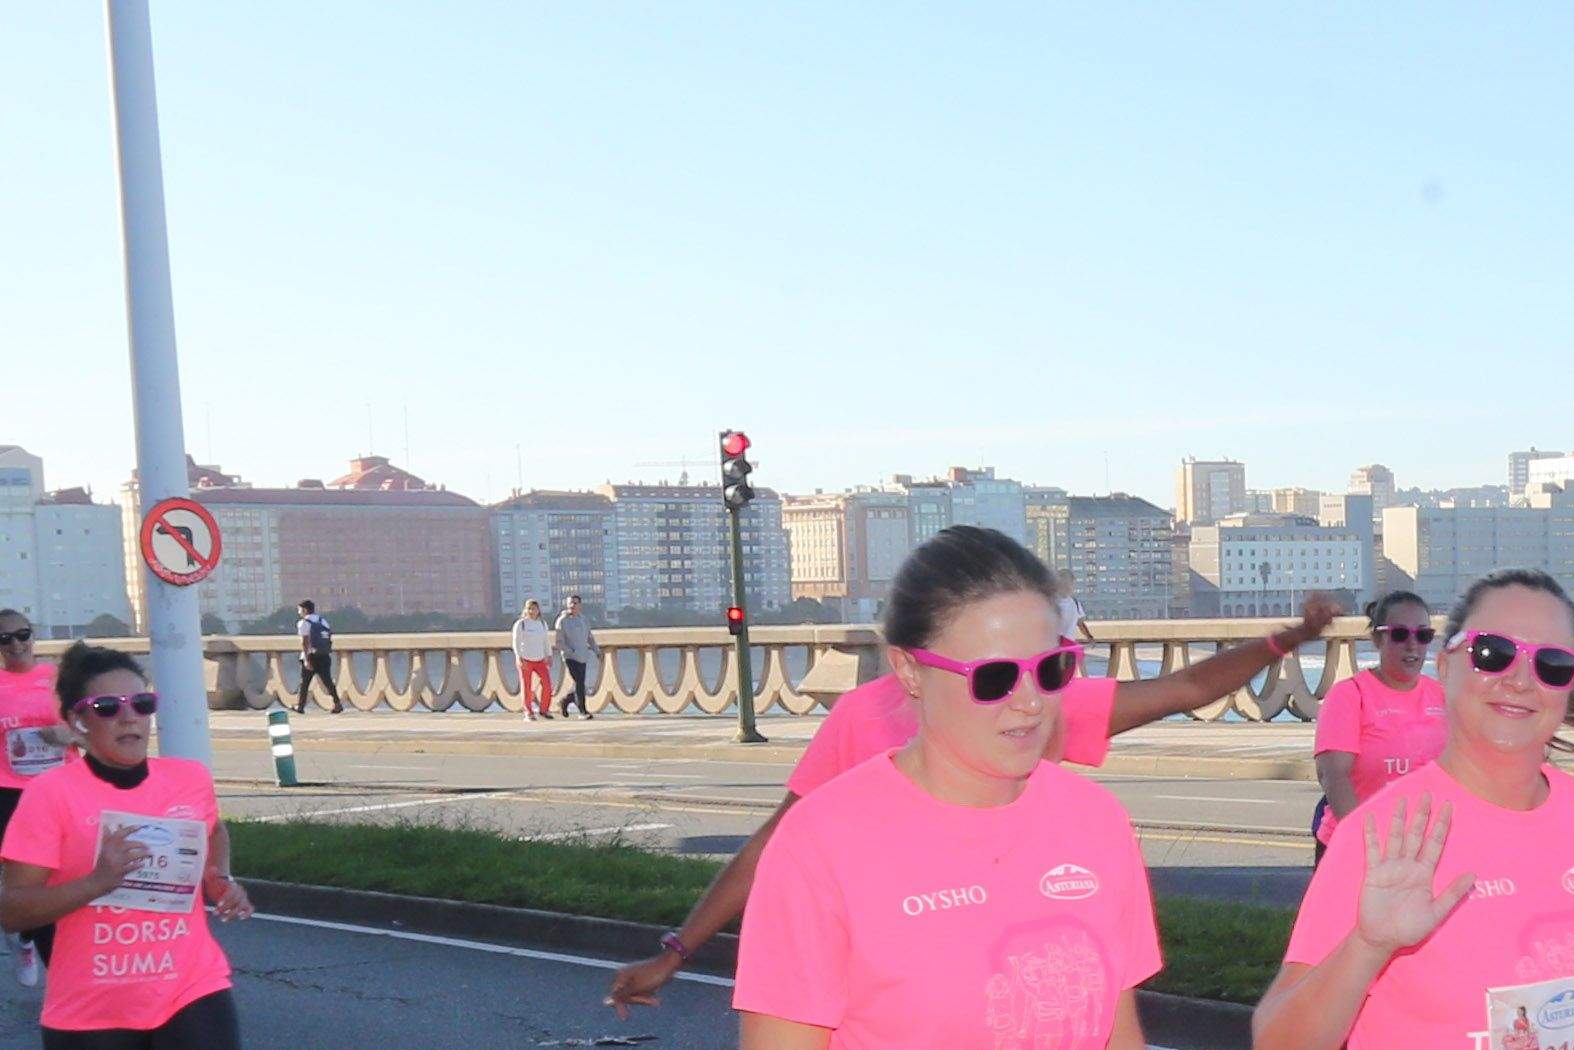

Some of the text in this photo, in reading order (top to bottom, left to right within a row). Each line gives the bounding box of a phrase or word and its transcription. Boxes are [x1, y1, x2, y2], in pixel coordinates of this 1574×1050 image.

[1383, 758, 1410, 775] TU
[902, 885, 987, 916] OYSHO
[93, 918, 190, 945] DORSA
[92, 950, 175, 977] SUMA
